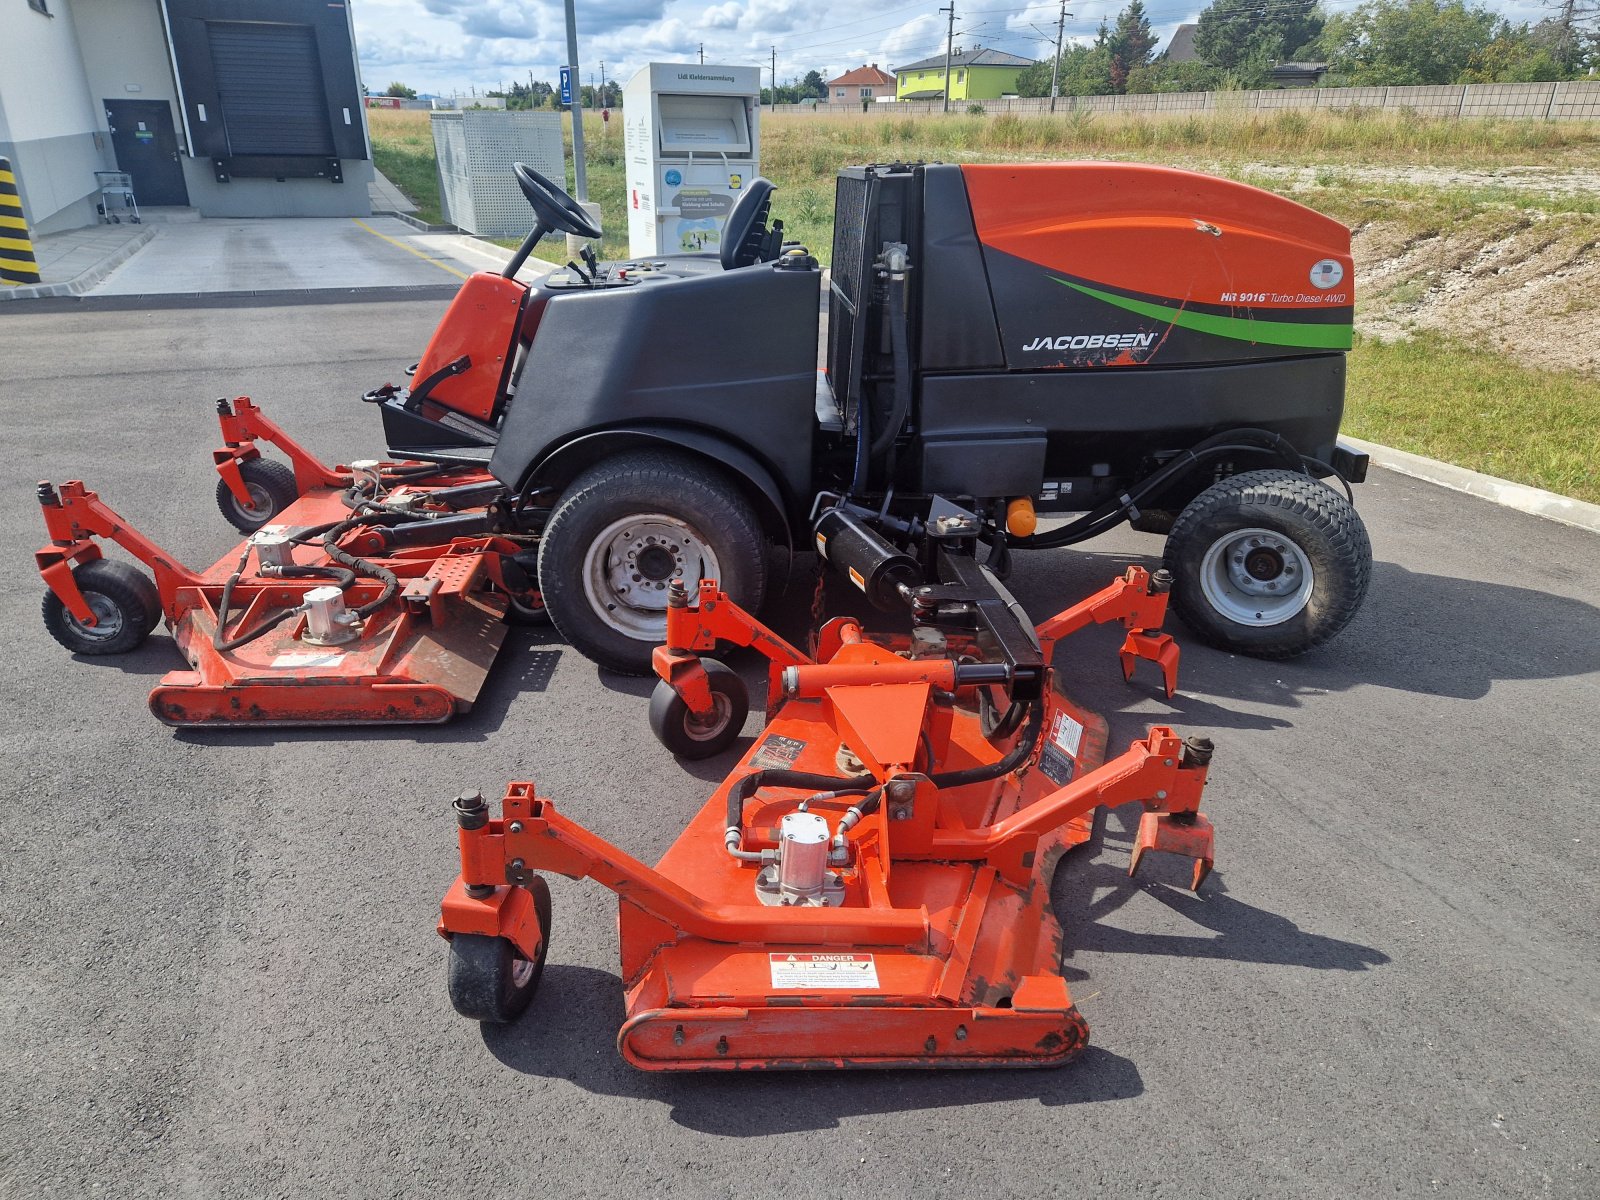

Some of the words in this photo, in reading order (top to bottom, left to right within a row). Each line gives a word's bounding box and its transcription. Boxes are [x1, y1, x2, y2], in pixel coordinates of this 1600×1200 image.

[1220, 292, 1238, 302] HR
[1239, 292, 1266, 302] 9016
[1270, 293, 1294, 303] Turbo
[1295, 293, 1324, 303] Diesel
[1324, 294, 1346, 303] 4WD
[1022, 332, 1155, 351] JACOBSEN
